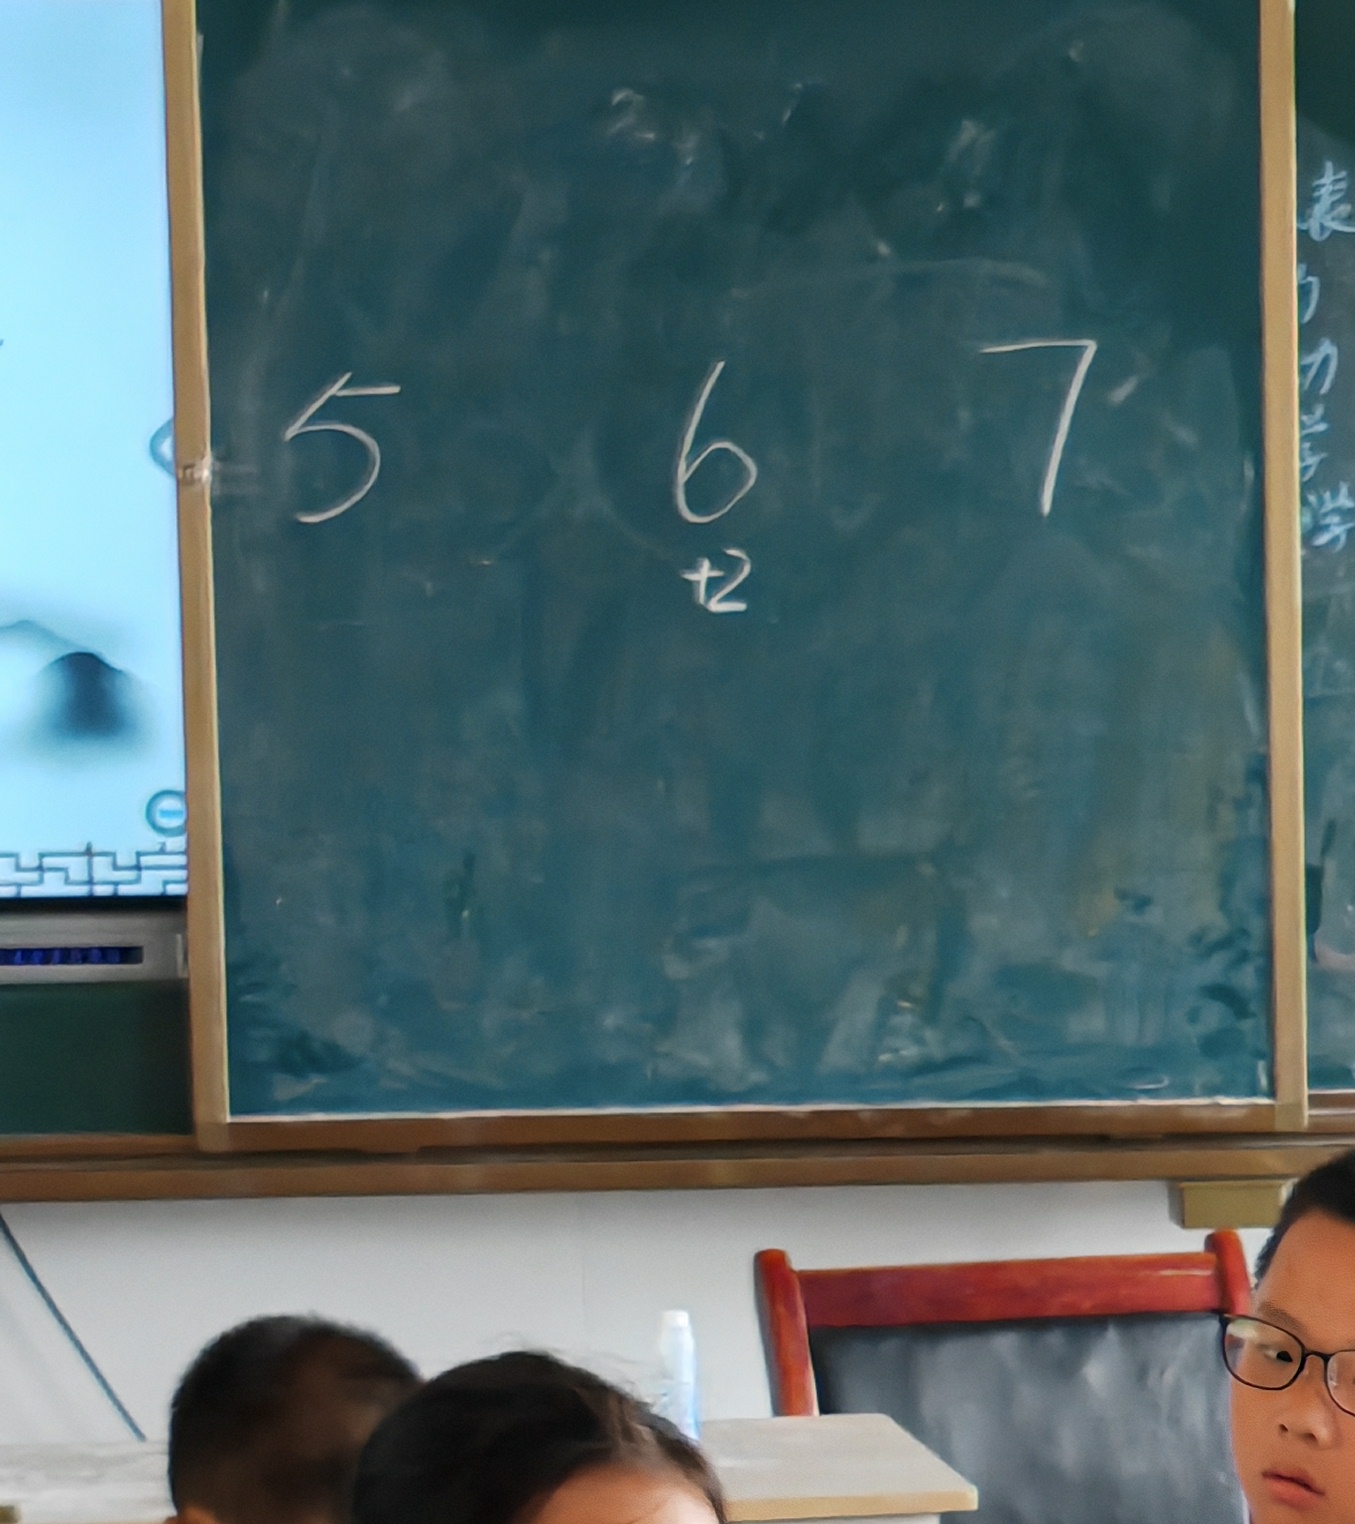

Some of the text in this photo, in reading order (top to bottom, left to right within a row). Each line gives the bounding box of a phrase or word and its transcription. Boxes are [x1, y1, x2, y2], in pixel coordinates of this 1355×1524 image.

[282, 338, 1098, 526] 5 6 7
